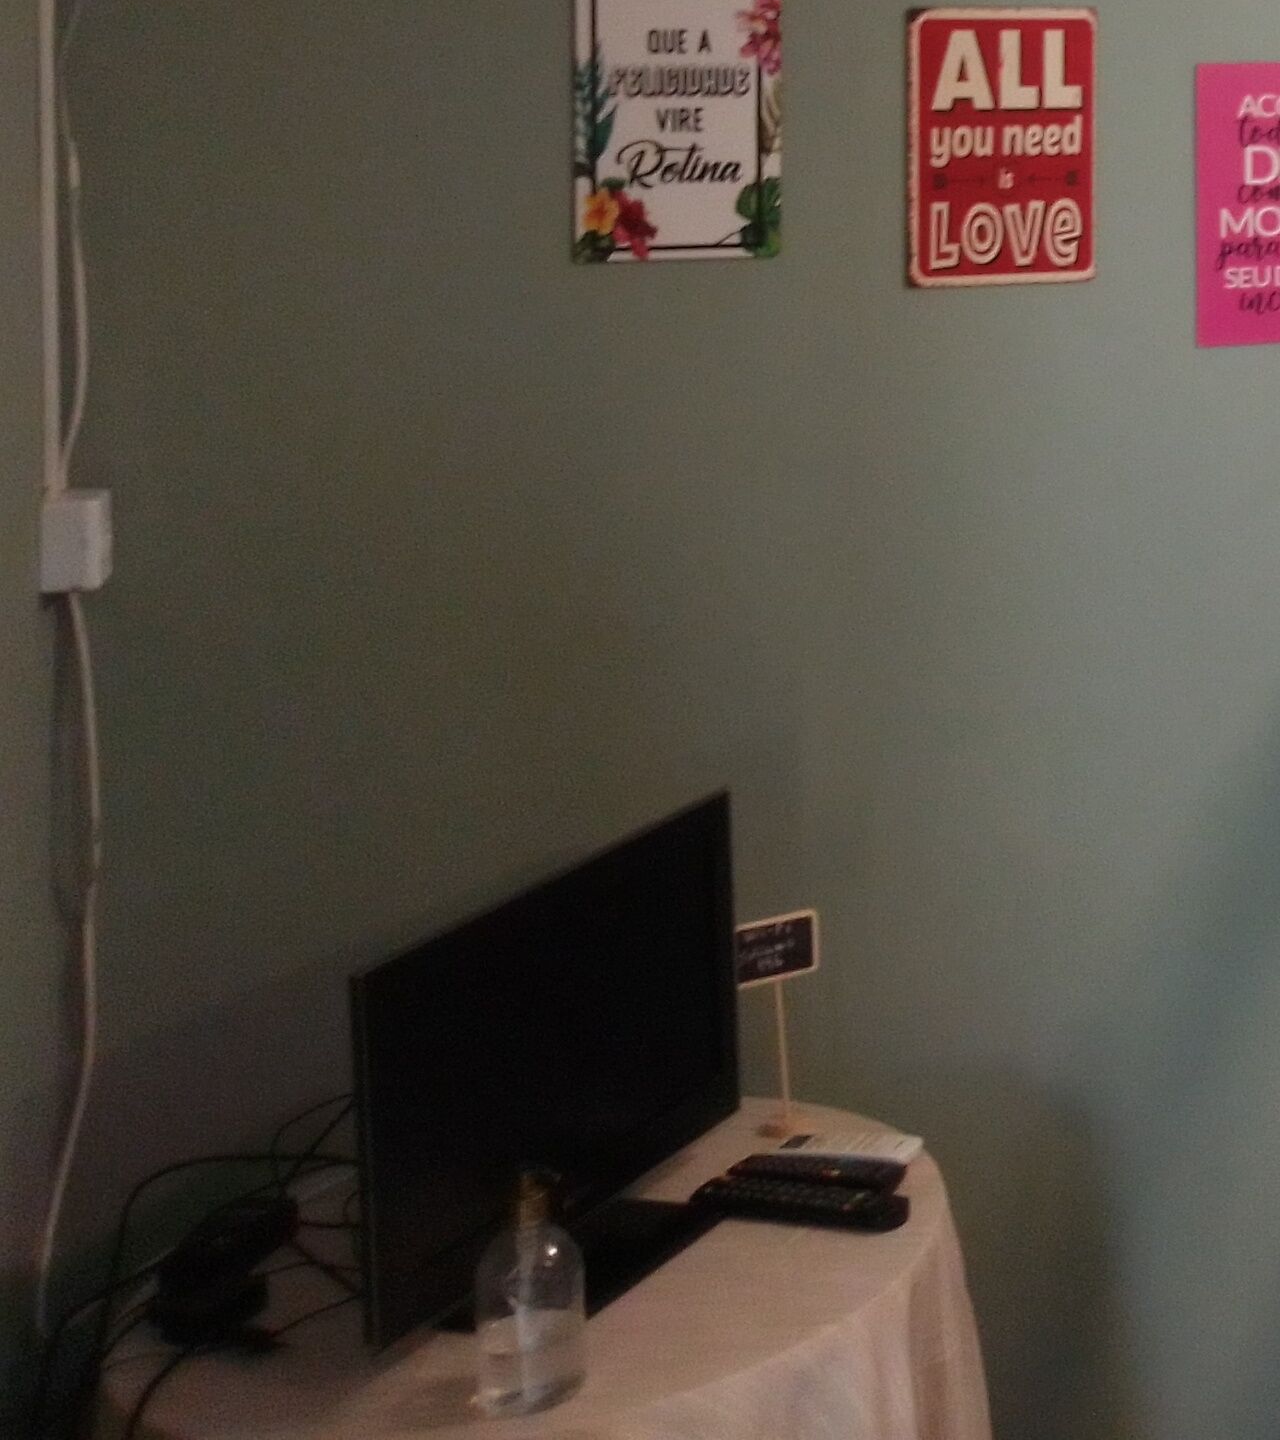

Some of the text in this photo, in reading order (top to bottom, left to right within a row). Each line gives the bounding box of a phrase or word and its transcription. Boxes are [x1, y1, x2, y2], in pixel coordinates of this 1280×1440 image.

[647, 29, 712, 54] QUE A
[931, 28, 1084, 111] ALL
[656, 107, 704, 132] VIRE
[929, 114, 1083, 168] you need
[617, 139, 743, 189] Rotina
[1224, 266, 1273, 289] SEU
